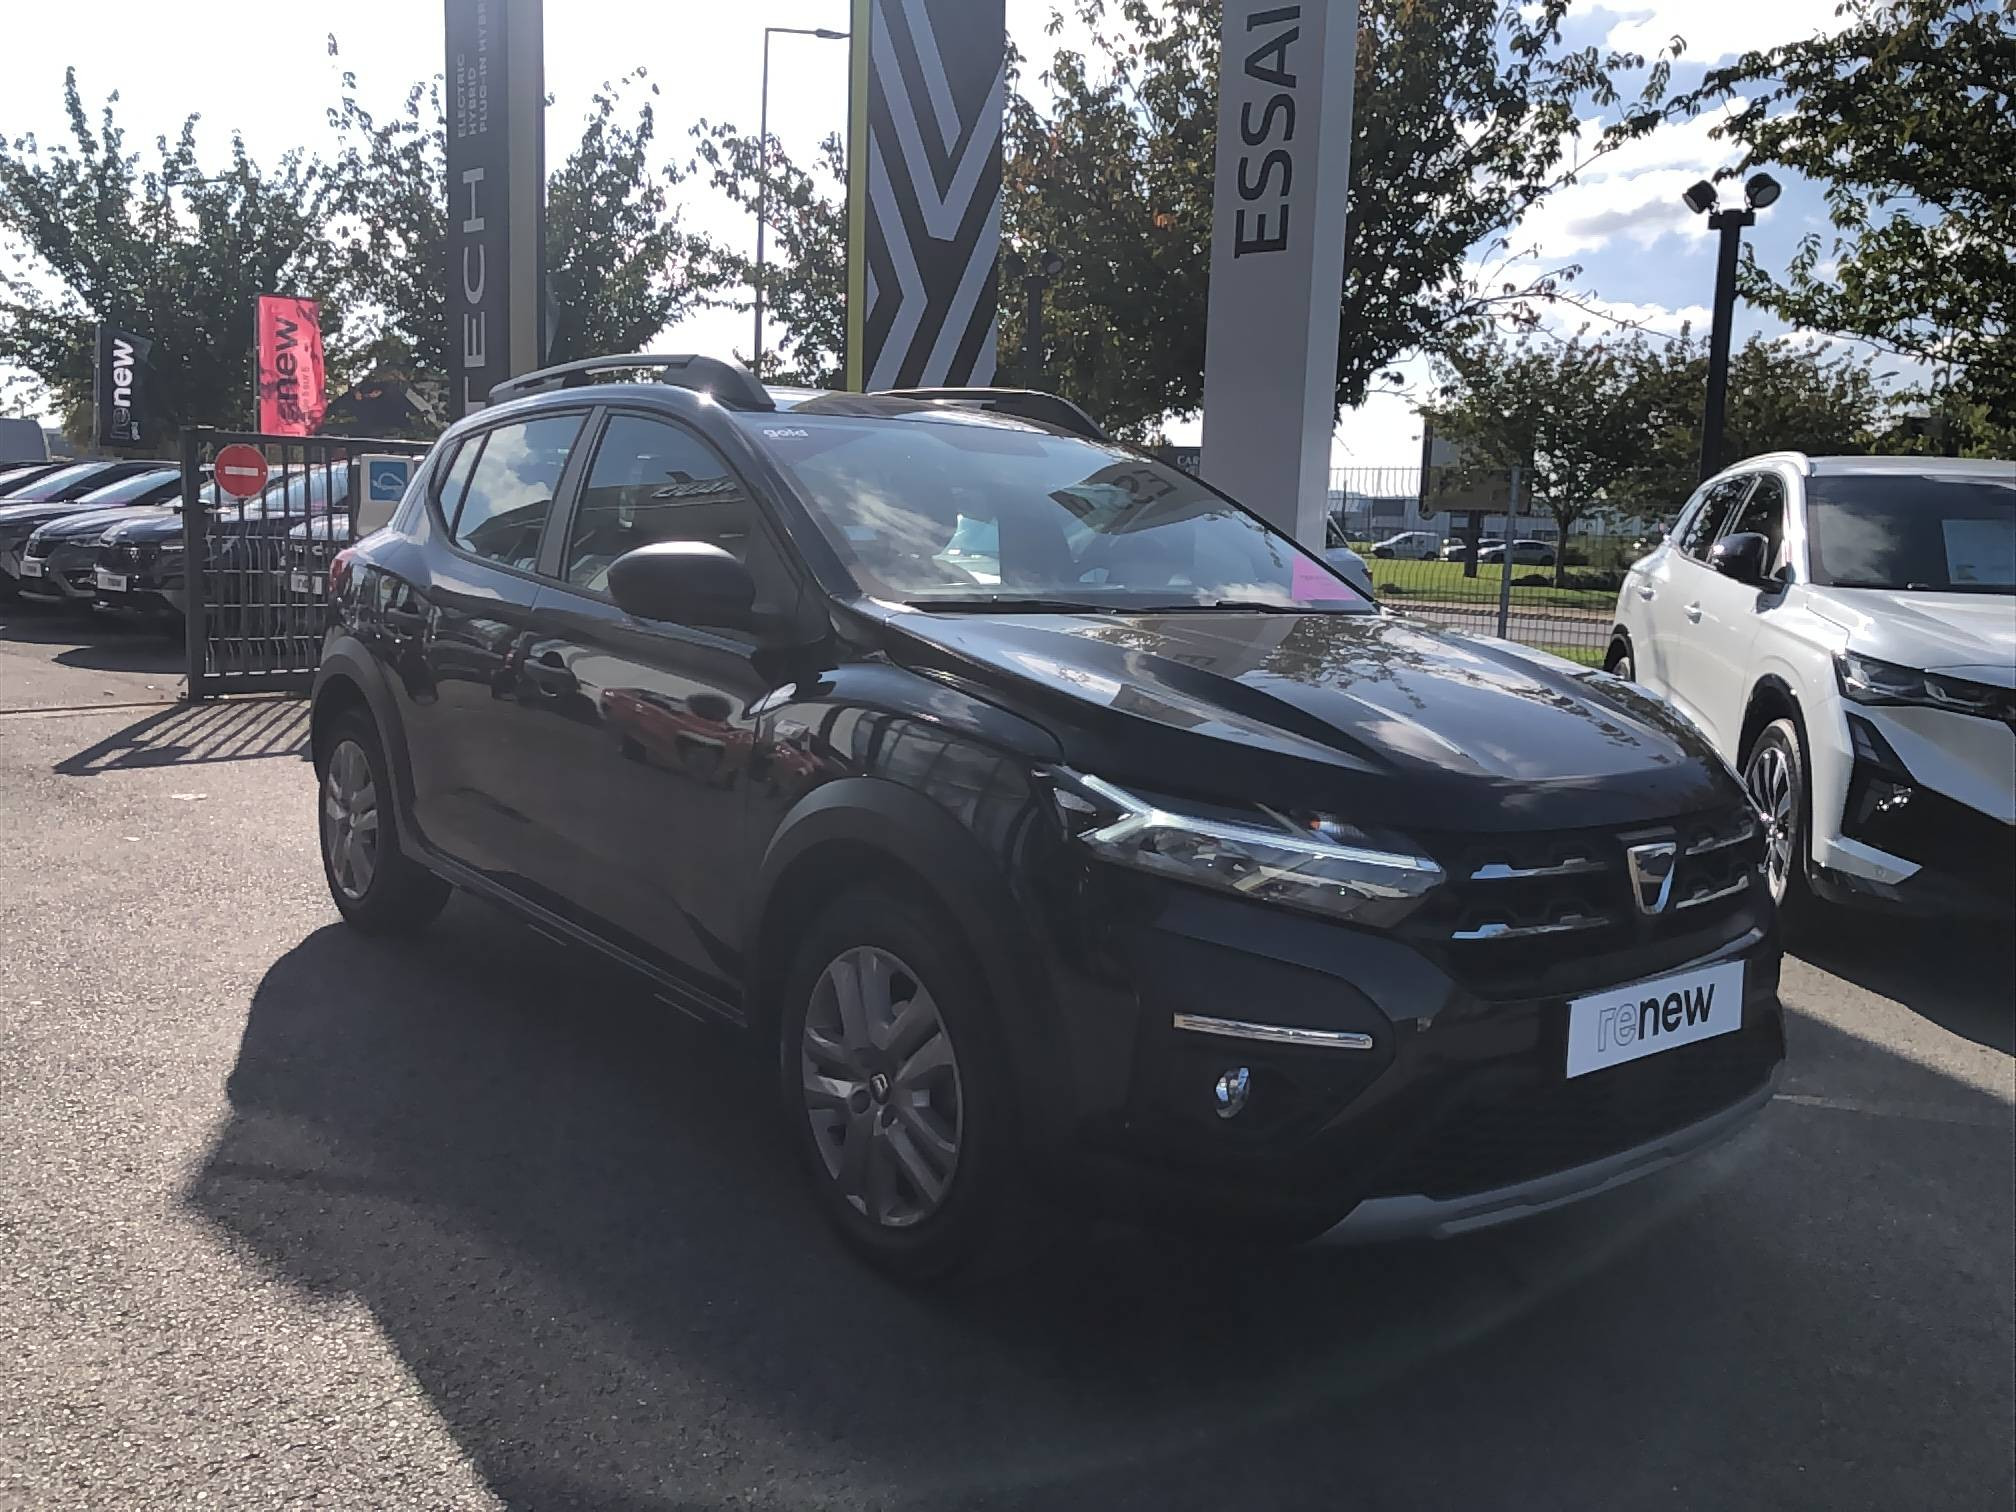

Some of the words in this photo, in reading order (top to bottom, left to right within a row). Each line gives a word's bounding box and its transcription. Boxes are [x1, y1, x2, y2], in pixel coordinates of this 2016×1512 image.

[477, 0, 488, 52] HYBR
[456, 53, 467, 138] ELECTRIC
[467, 67, 477, 136] HYBRID
[478, 56, 488, 133] PLUG-IN
[1234, 5, 1301, 259] ESSAI
[463, 167, 486, 415] TECH
[110, 338, 134, 440] renew
[1597, 983, 1715, 1052] renew
